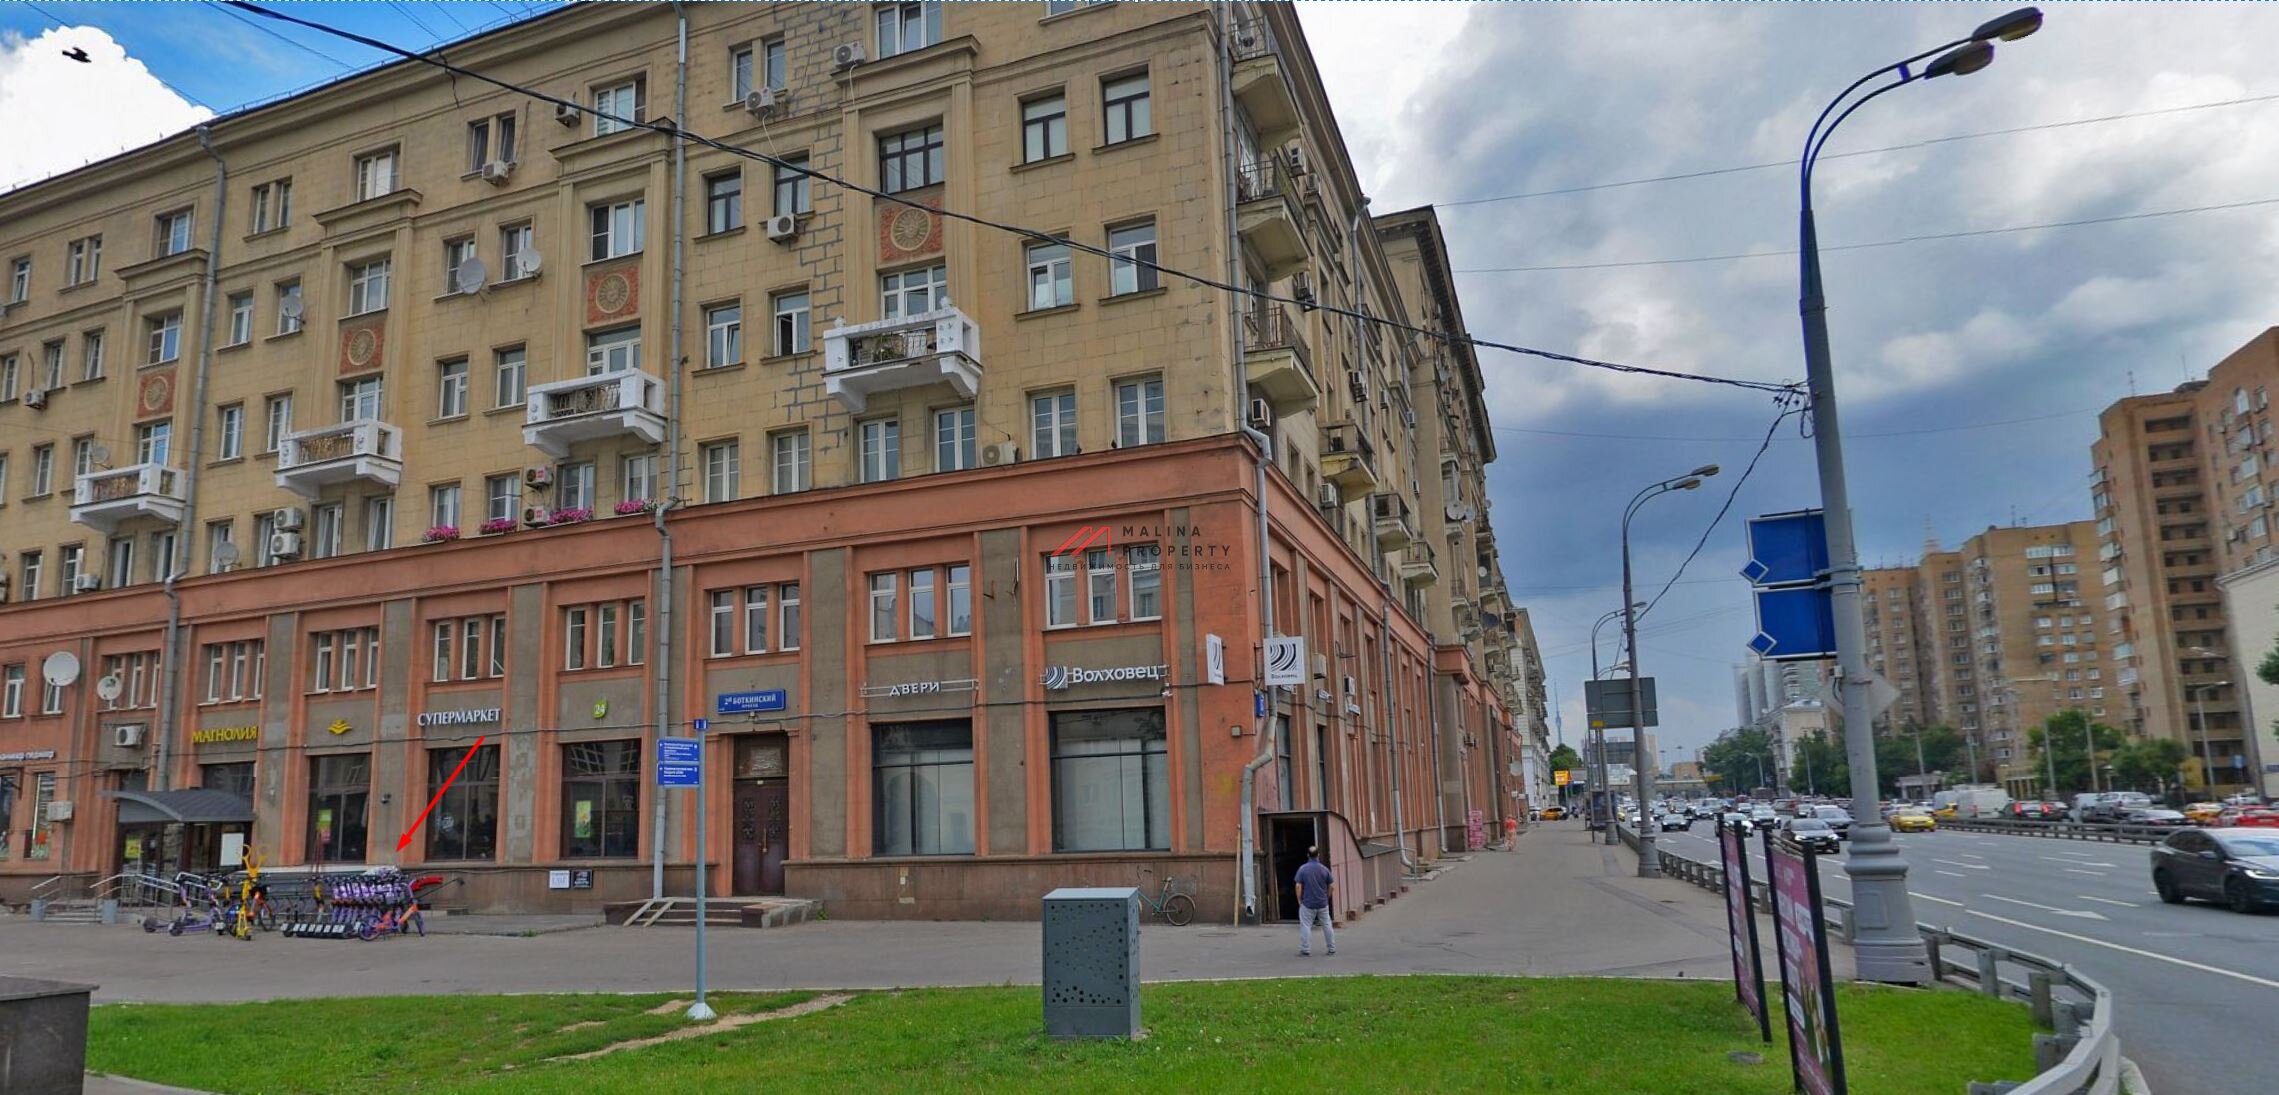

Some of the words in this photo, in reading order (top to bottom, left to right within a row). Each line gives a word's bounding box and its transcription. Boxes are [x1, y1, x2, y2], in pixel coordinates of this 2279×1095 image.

[1072, 665, 1159, 683] Волховец
[889, 681, 940, 697] ДВЕРИ
[417, 707, 502, 726] СУПЕРМАРКЕТ
[192, 725, 258, 743] МАГНОЛИЯ
